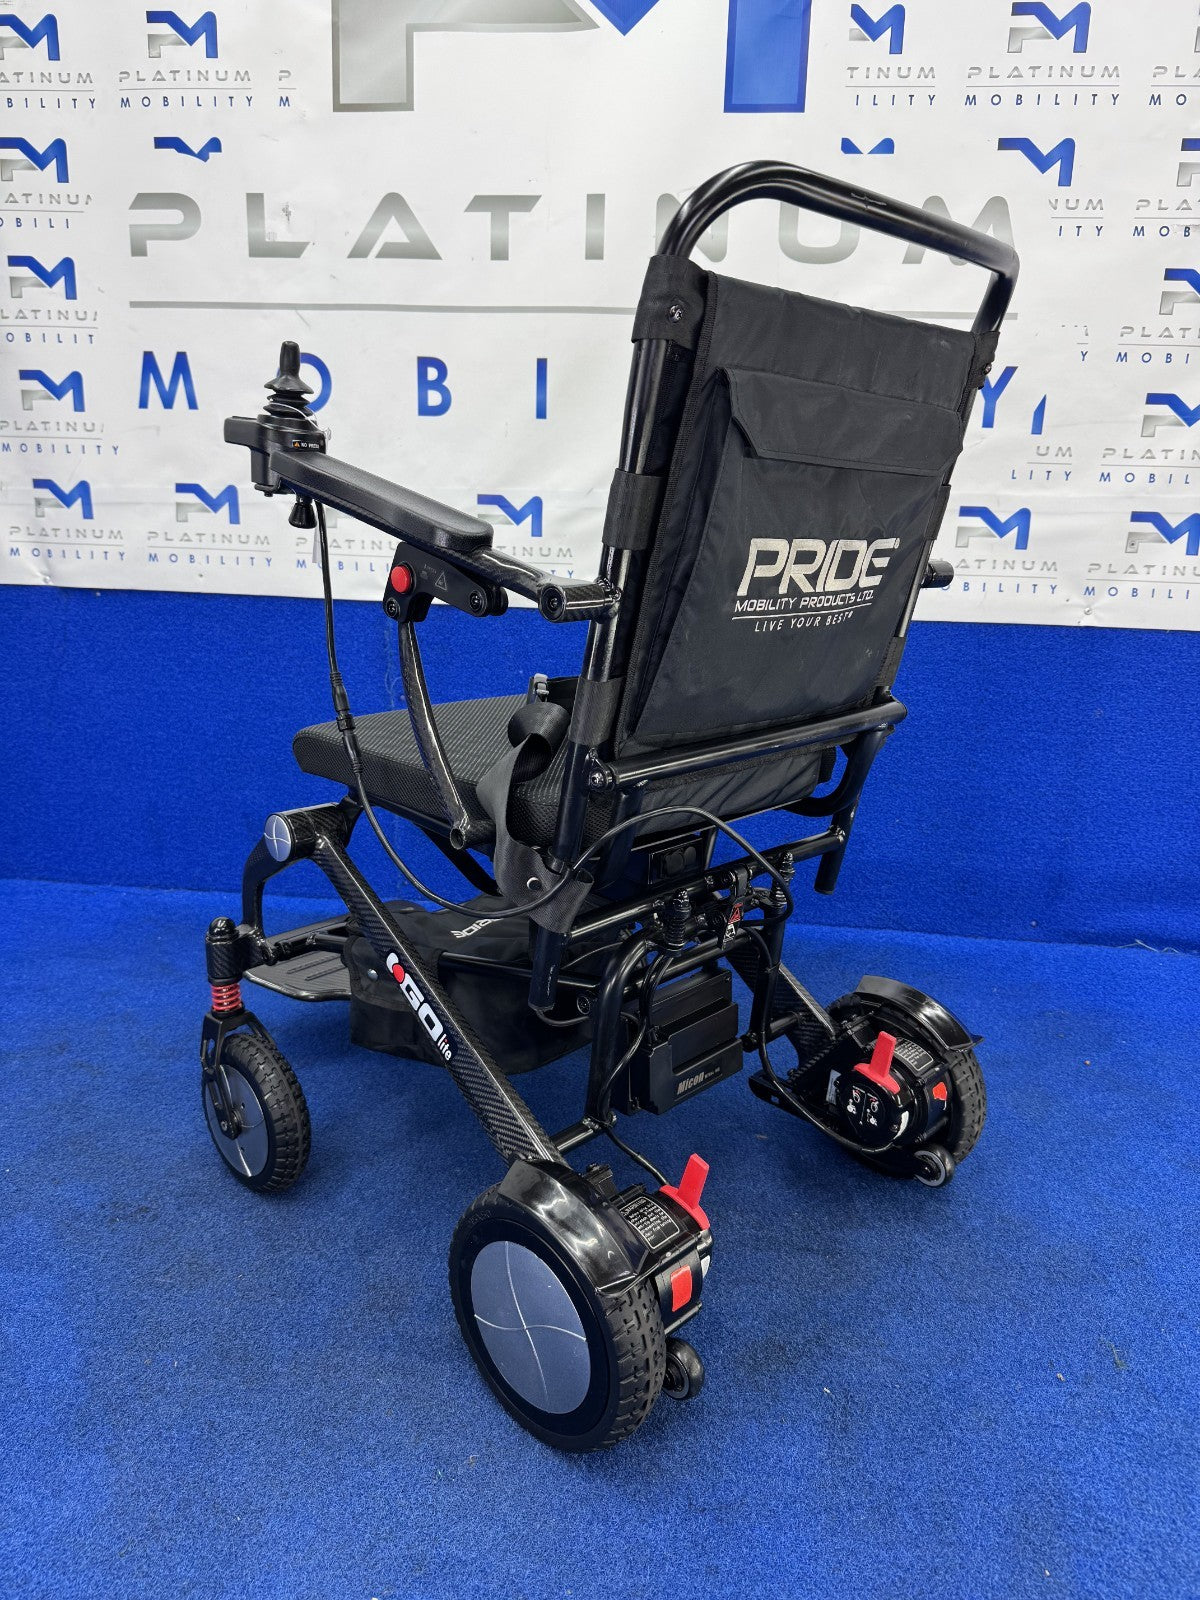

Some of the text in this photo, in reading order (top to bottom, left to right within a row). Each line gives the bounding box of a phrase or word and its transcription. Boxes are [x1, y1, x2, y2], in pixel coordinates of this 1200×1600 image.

[119, 70, 251, 82] PLATINUM
[967, 66, 1120, 78] PLATINUM
[120, 96, 253, 108] MOBILITY
[964, 94, 1119, 106] MOBILITY
[2, 443, 119, 455] MOBILITY
[9, 526, 123, 540] PLATINUM
[148, 531, 270, 546] PLATINUM
[10, 548, 125, 561] MOBILITY
[148, 553, 272, 567] MOBILITY
[737, 537, 900, 596] PRIDE
[930, 558, 1058, 571] ATINUM
[921, 582, 1057, 594] BILITY
[735, 598, 797, 612] MOBILITY
[800, 594, 856, 609] PRODUCTS
[755, 619, 784, 632] LIVE
[791, 616, 820, 629] YOUR
[437, 1034, 452, 1061] lite
